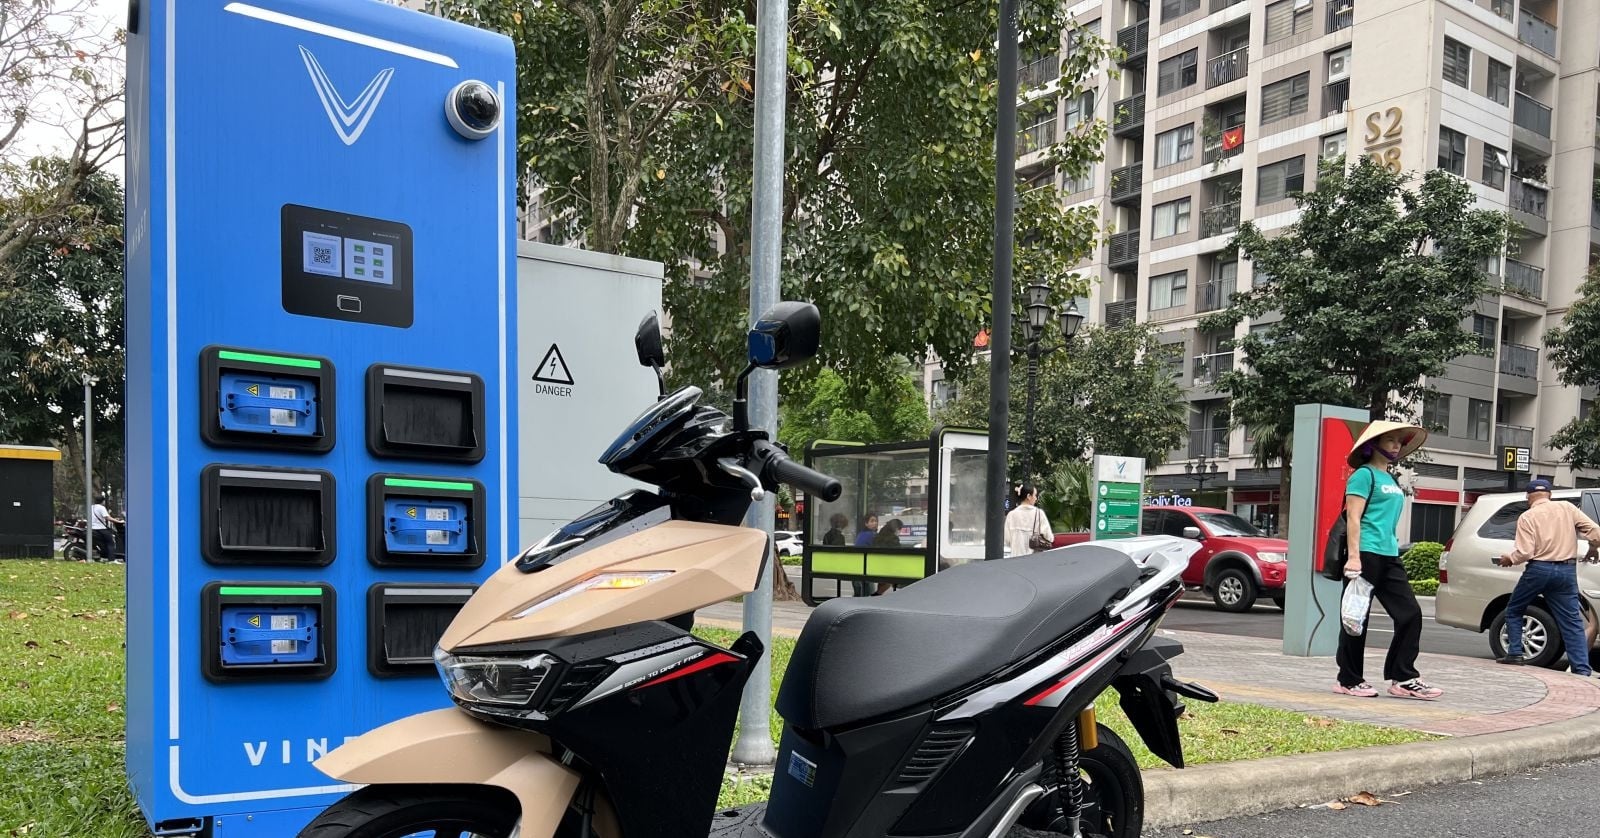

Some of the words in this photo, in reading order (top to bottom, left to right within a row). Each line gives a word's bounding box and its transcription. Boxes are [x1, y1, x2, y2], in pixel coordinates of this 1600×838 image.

[1365, 107, 1403, 145] S2
[535, 384, 572, 397] DANGER
[1171, 494, 1192, 506] Tea
[648, 670, 659, 678] TO
[660, 662, 682, 673] DRIFT
[683, 650, 704, 664] FREE
[243, 736, 361, 766] VIN
